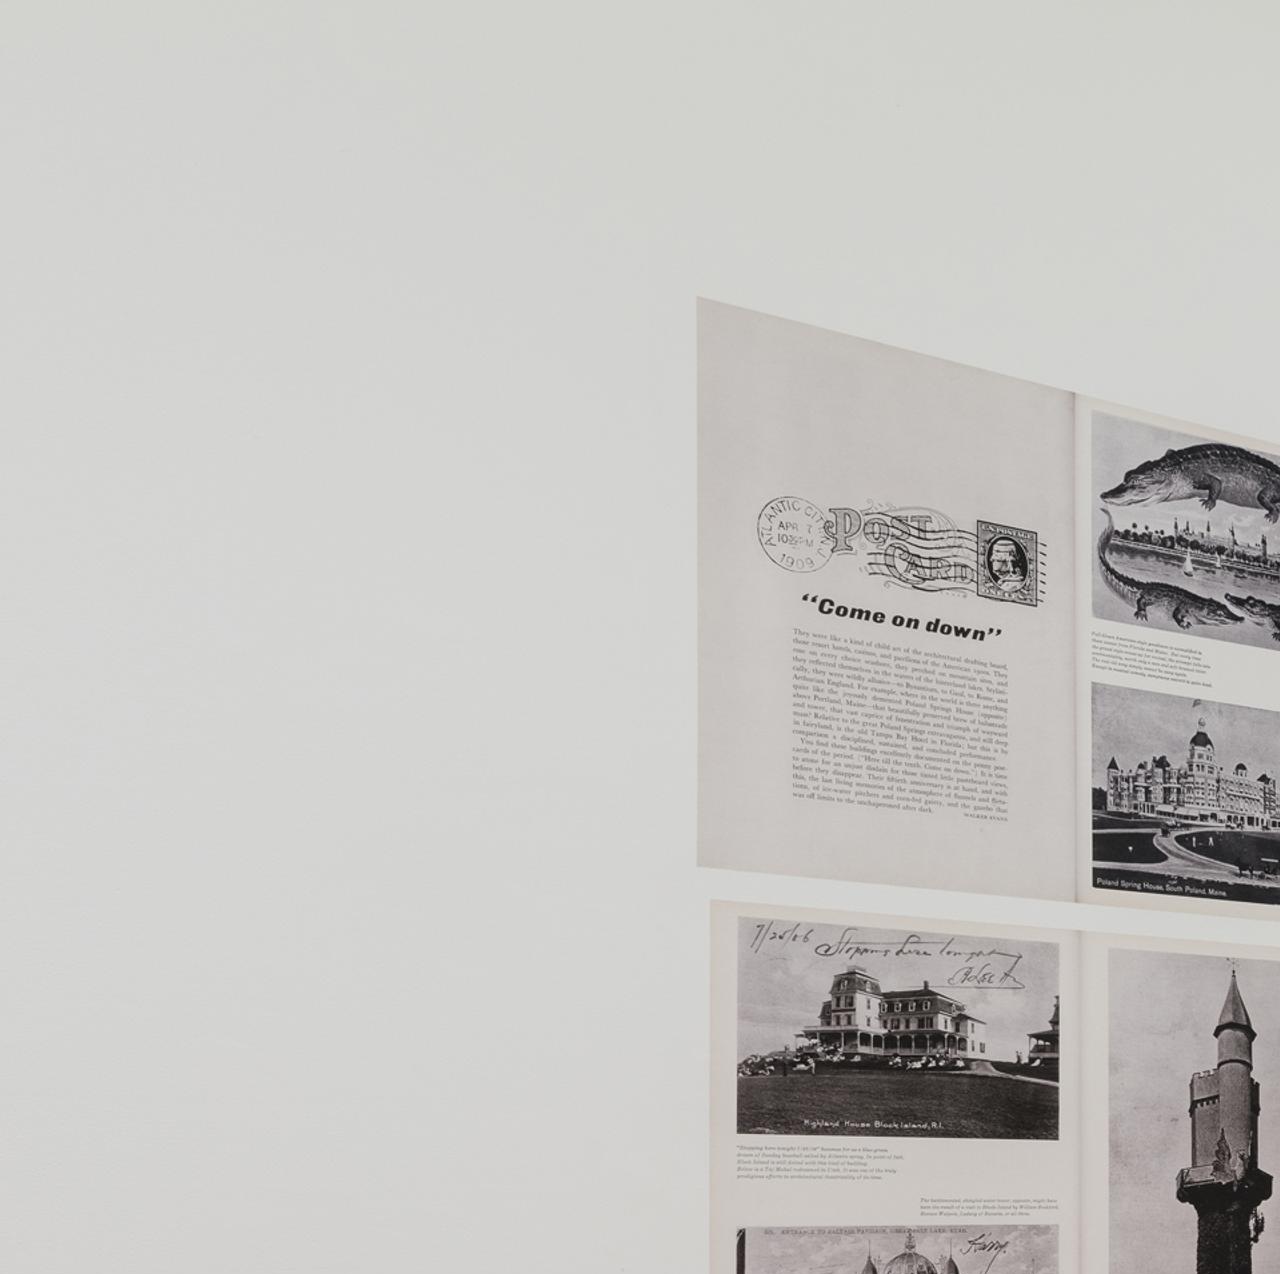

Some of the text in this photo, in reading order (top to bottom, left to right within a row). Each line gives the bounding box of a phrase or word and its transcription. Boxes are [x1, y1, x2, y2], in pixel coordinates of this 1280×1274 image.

[761, 499, 801, 547] ATLANTIC
[778, 520, 799, 533] APR
[823, 508, 932, 553] POST
[779, 553, 816, 570] 1909
[802, 593, 1002, 642] “Come on down”
[874, 1120, 898, 1129] Block
